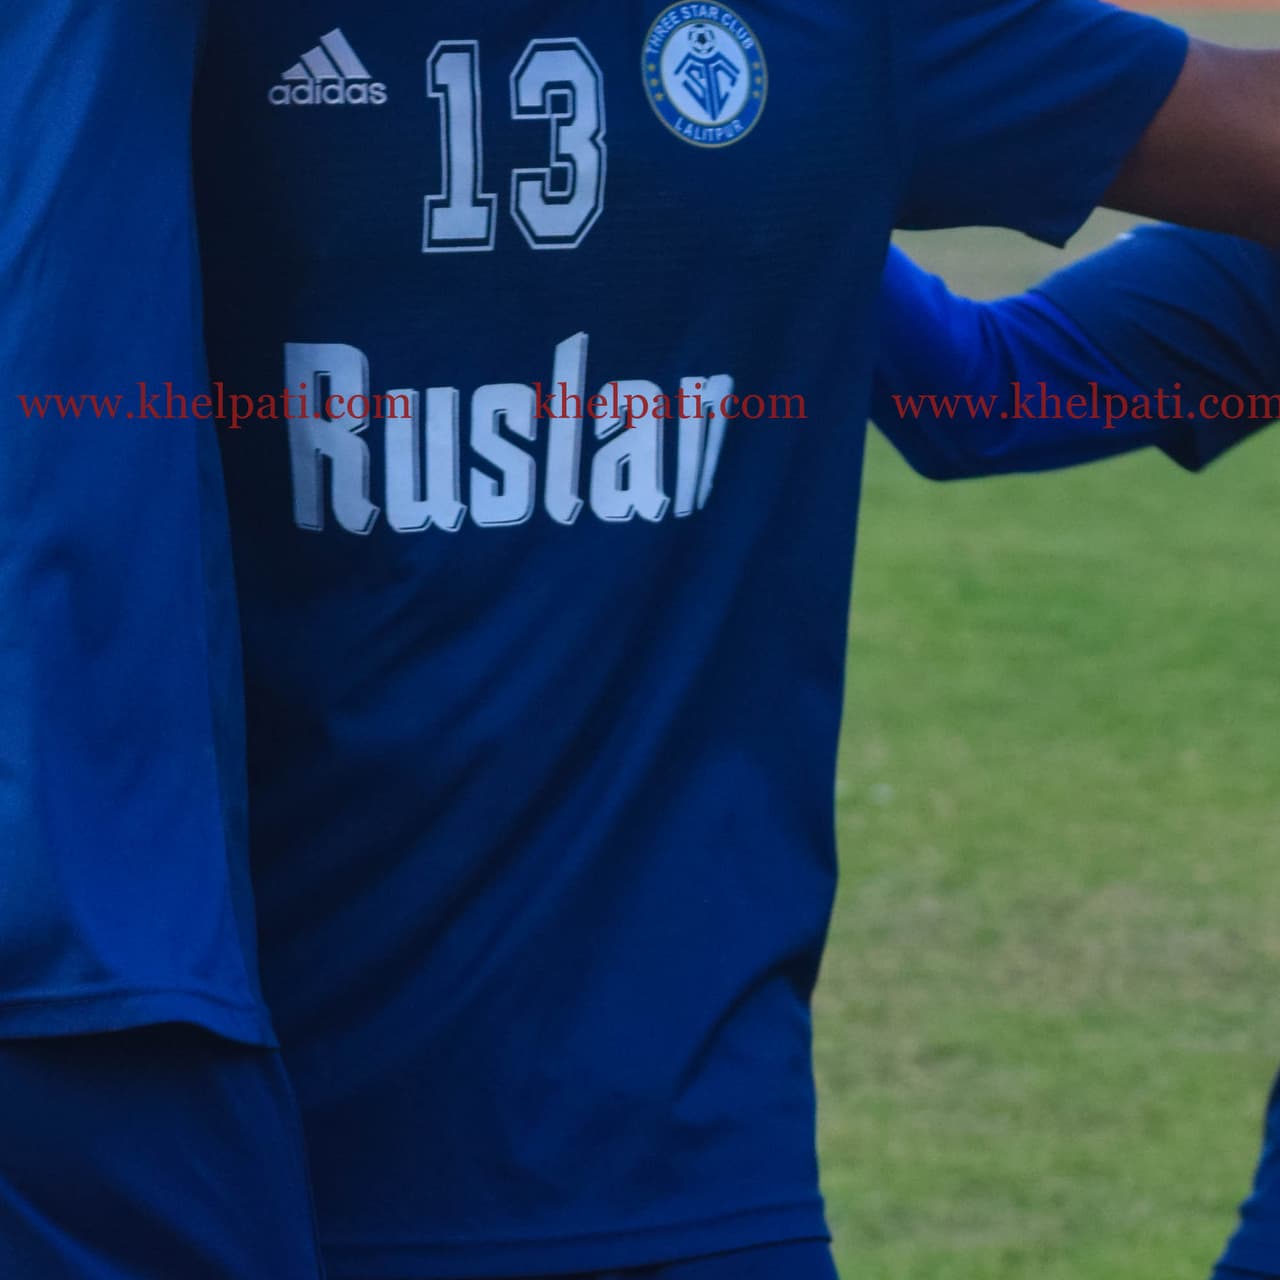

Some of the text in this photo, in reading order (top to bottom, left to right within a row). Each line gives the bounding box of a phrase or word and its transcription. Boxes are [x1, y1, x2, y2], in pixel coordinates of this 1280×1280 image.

[646, 4, 754, 55] THREE STAR CLUB
[268, 76, 388, 105] adidas
[422, 37, 608, 253] 13
[675, 116, 745, 142] LALITPUR
[284, 331, 735, 535] Ruslan
